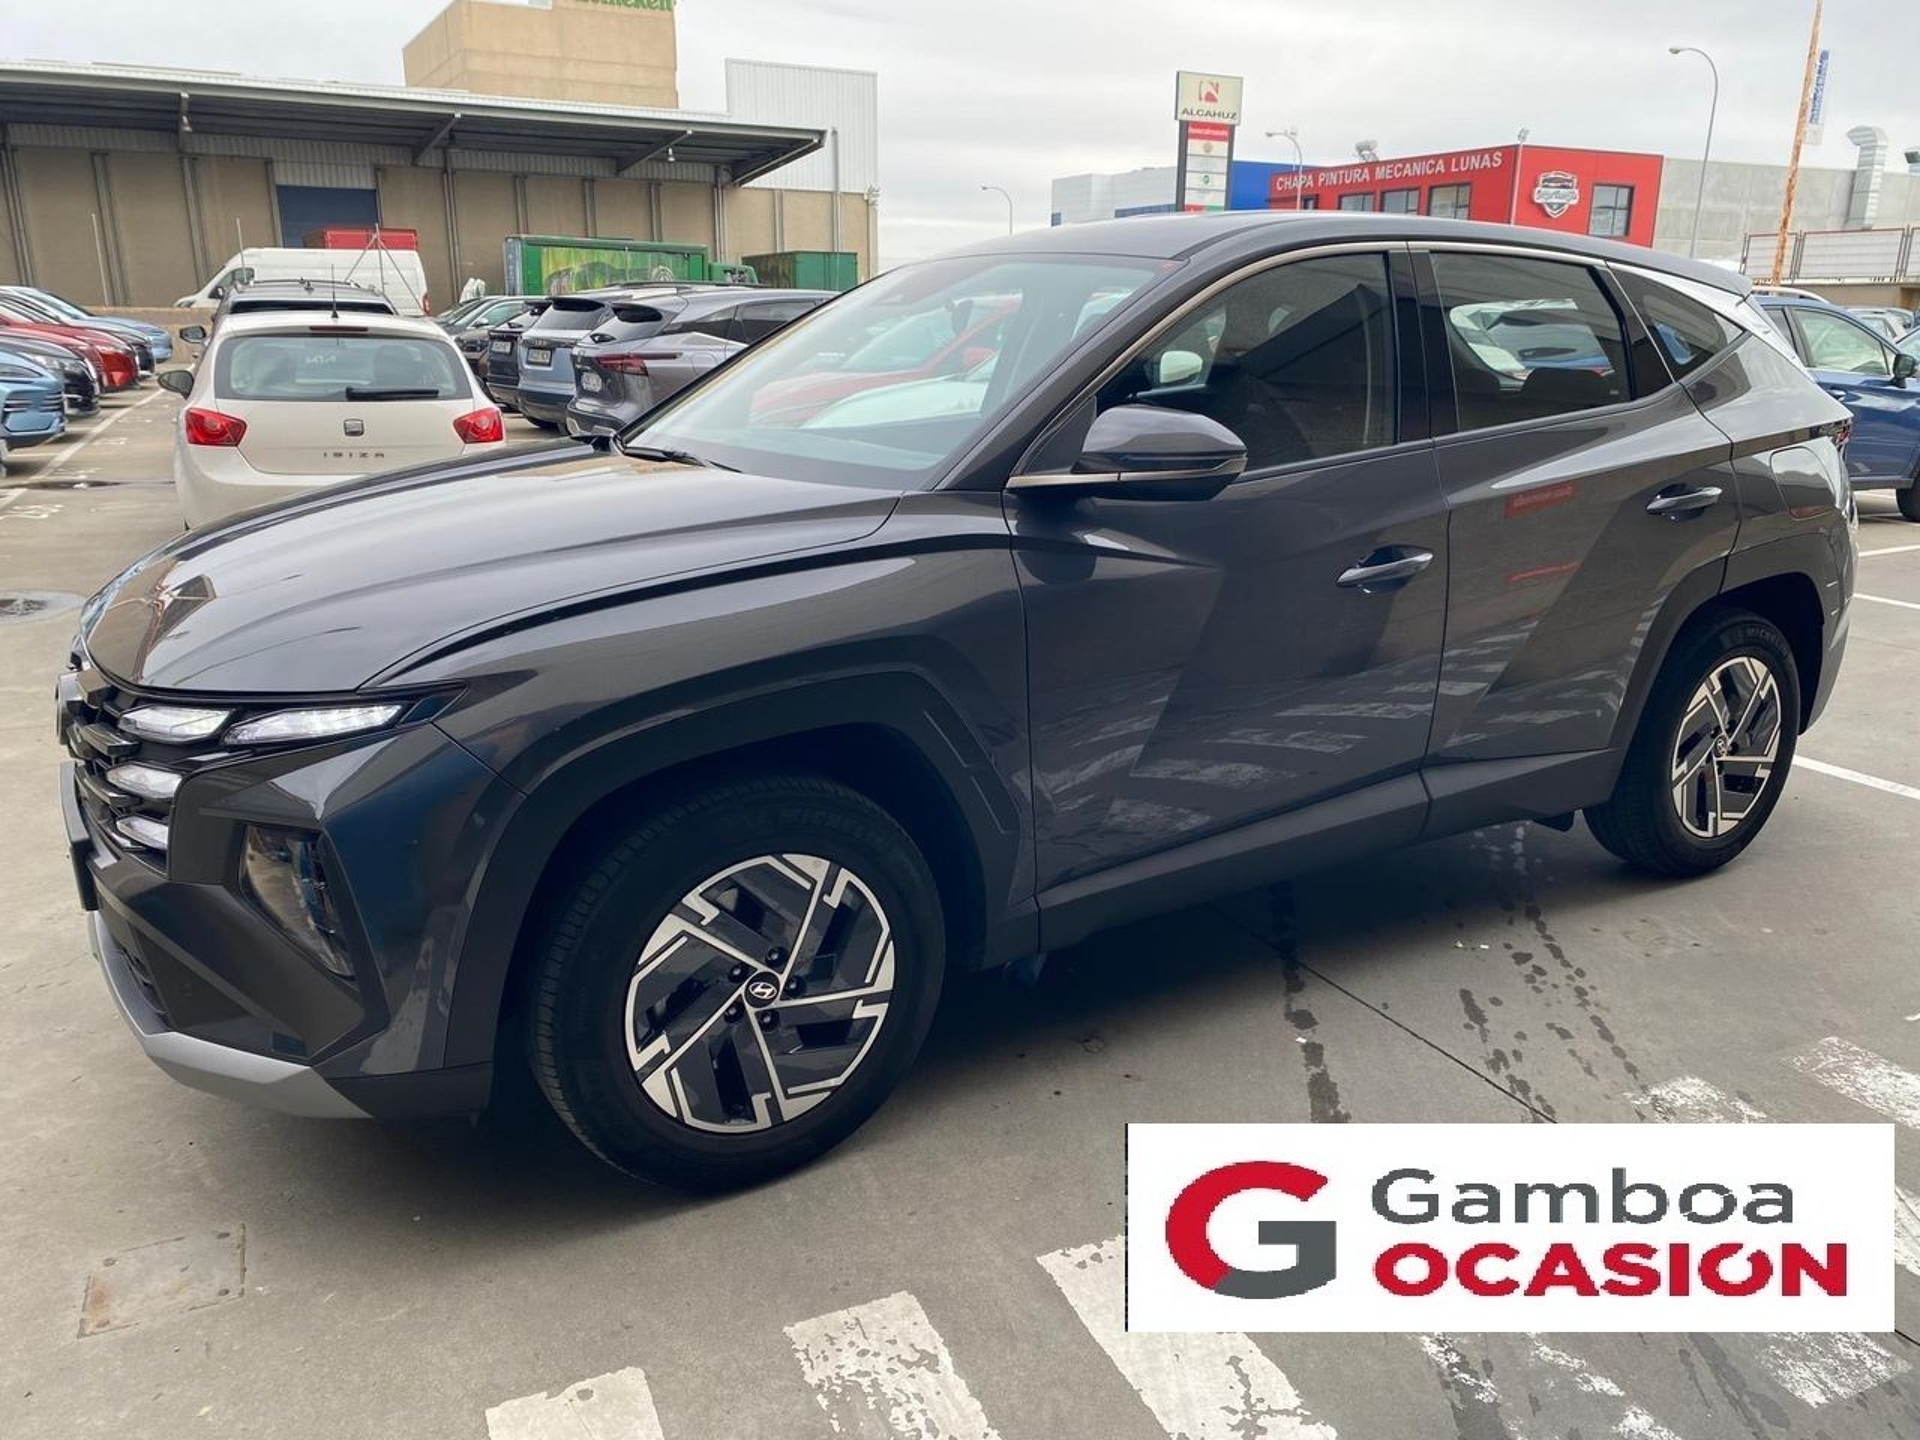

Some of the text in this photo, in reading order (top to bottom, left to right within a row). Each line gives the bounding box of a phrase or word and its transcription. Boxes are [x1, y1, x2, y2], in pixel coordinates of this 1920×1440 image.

[1181, 107, 1238, 120] ALCAHUZ
[1276, 151, 1503, 191] CHAPA PINTURA MECANICA LUNAS
